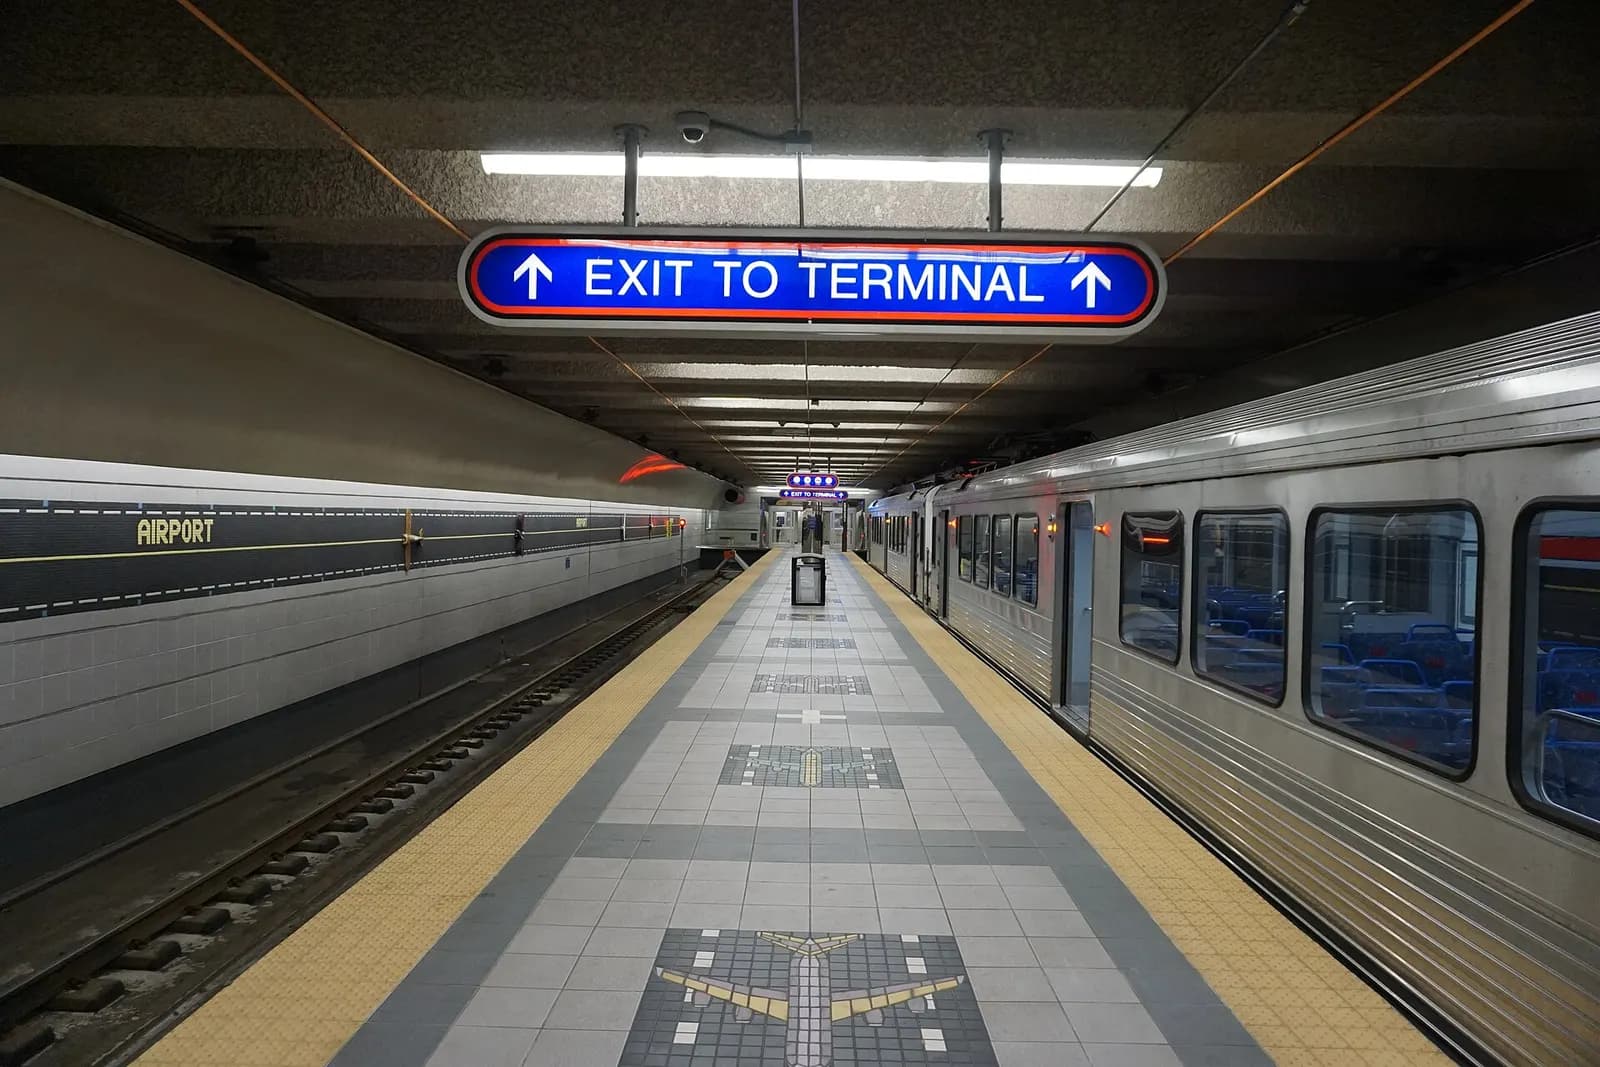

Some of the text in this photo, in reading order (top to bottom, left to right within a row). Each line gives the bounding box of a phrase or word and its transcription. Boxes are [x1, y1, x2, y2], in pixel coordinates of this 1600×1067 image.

[585, 258, 1045, 302] EXIT TO TERMINAL
[137, 518, 214, 545] AIRPORT
